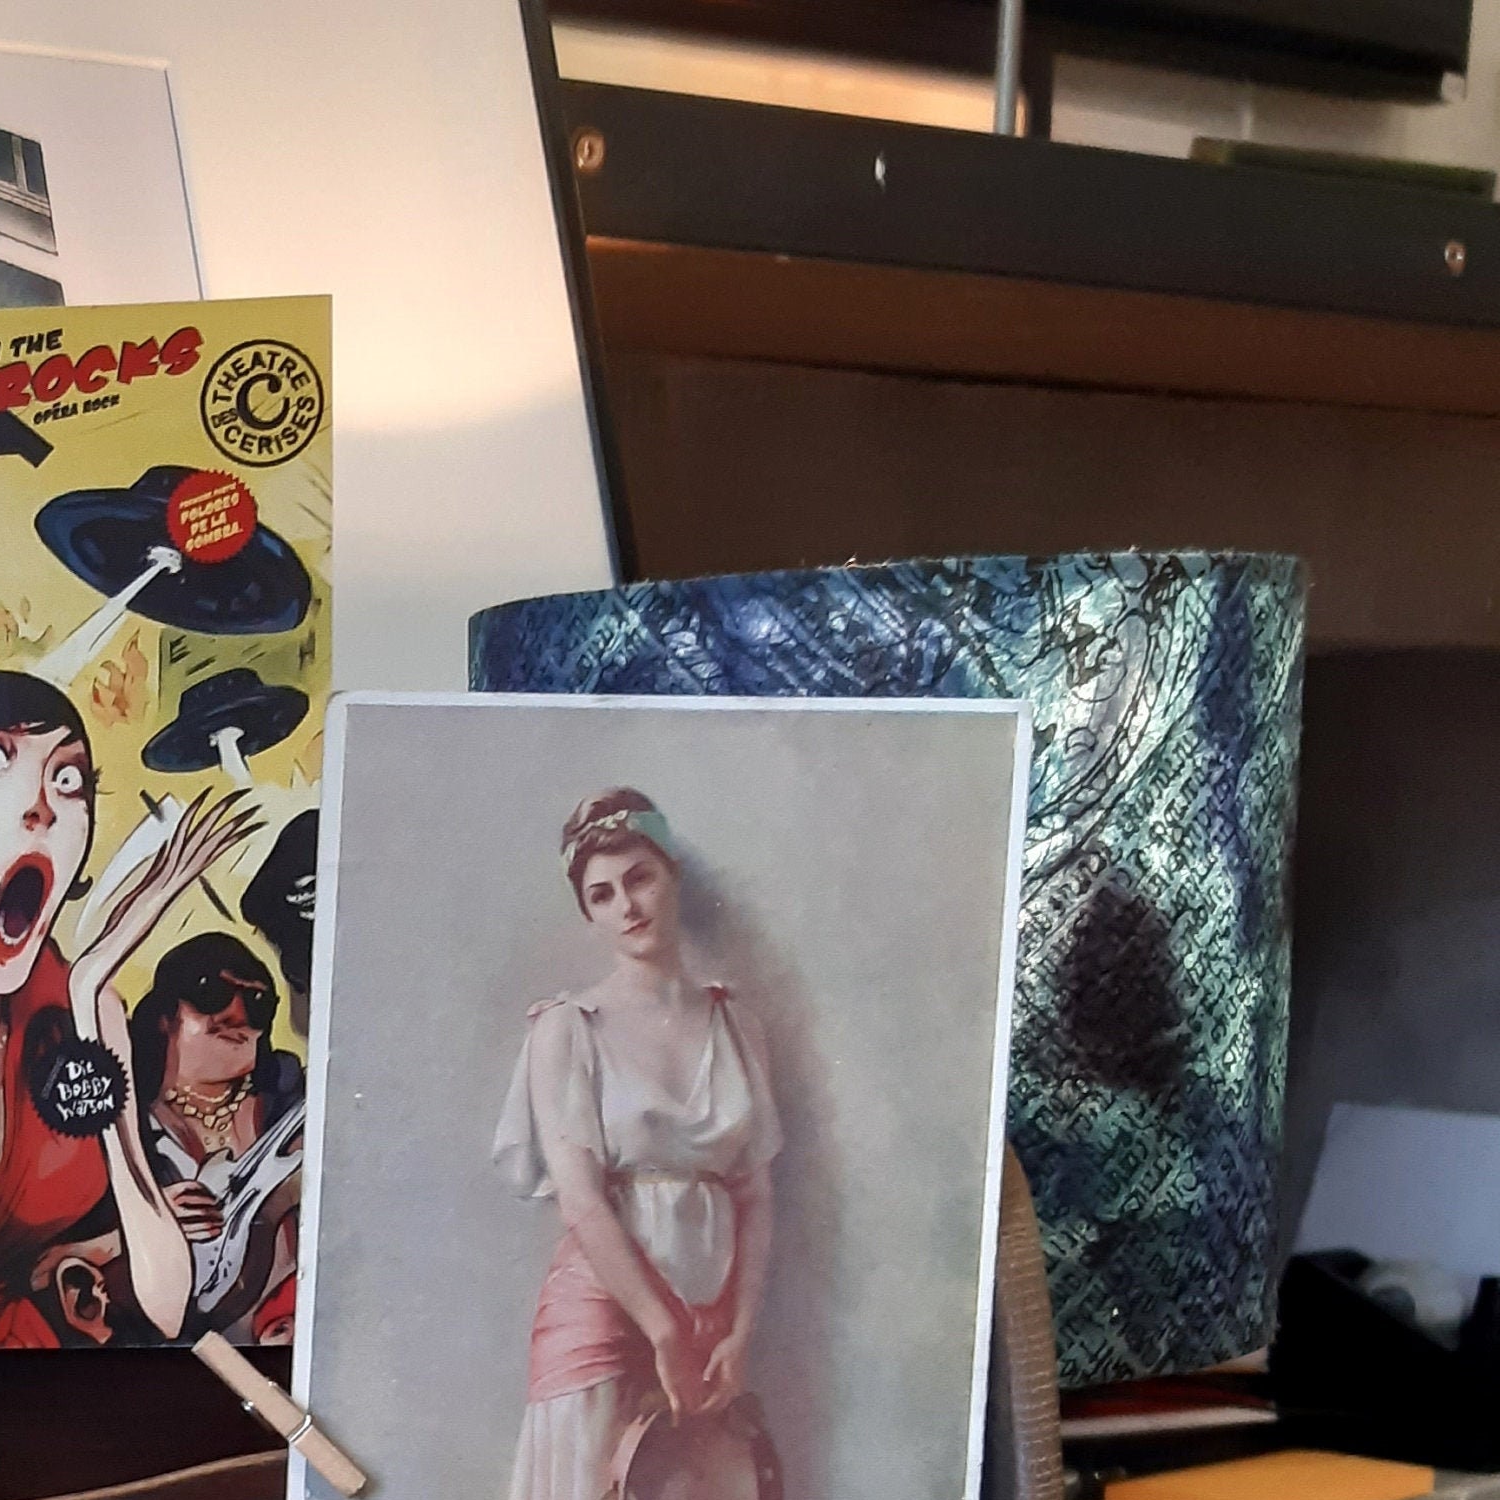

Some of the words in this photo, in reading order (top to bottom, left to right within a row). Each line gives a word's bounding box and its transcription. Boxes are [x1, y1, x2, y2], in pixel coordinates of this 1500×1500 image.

[10, 328, 63, 357] THE
[82, 394, 121, 415] ROCK
[236, 372, 290, 431] C
[211, 407, 238, 428] DES
[223, 395, 317, 455] CERISES
